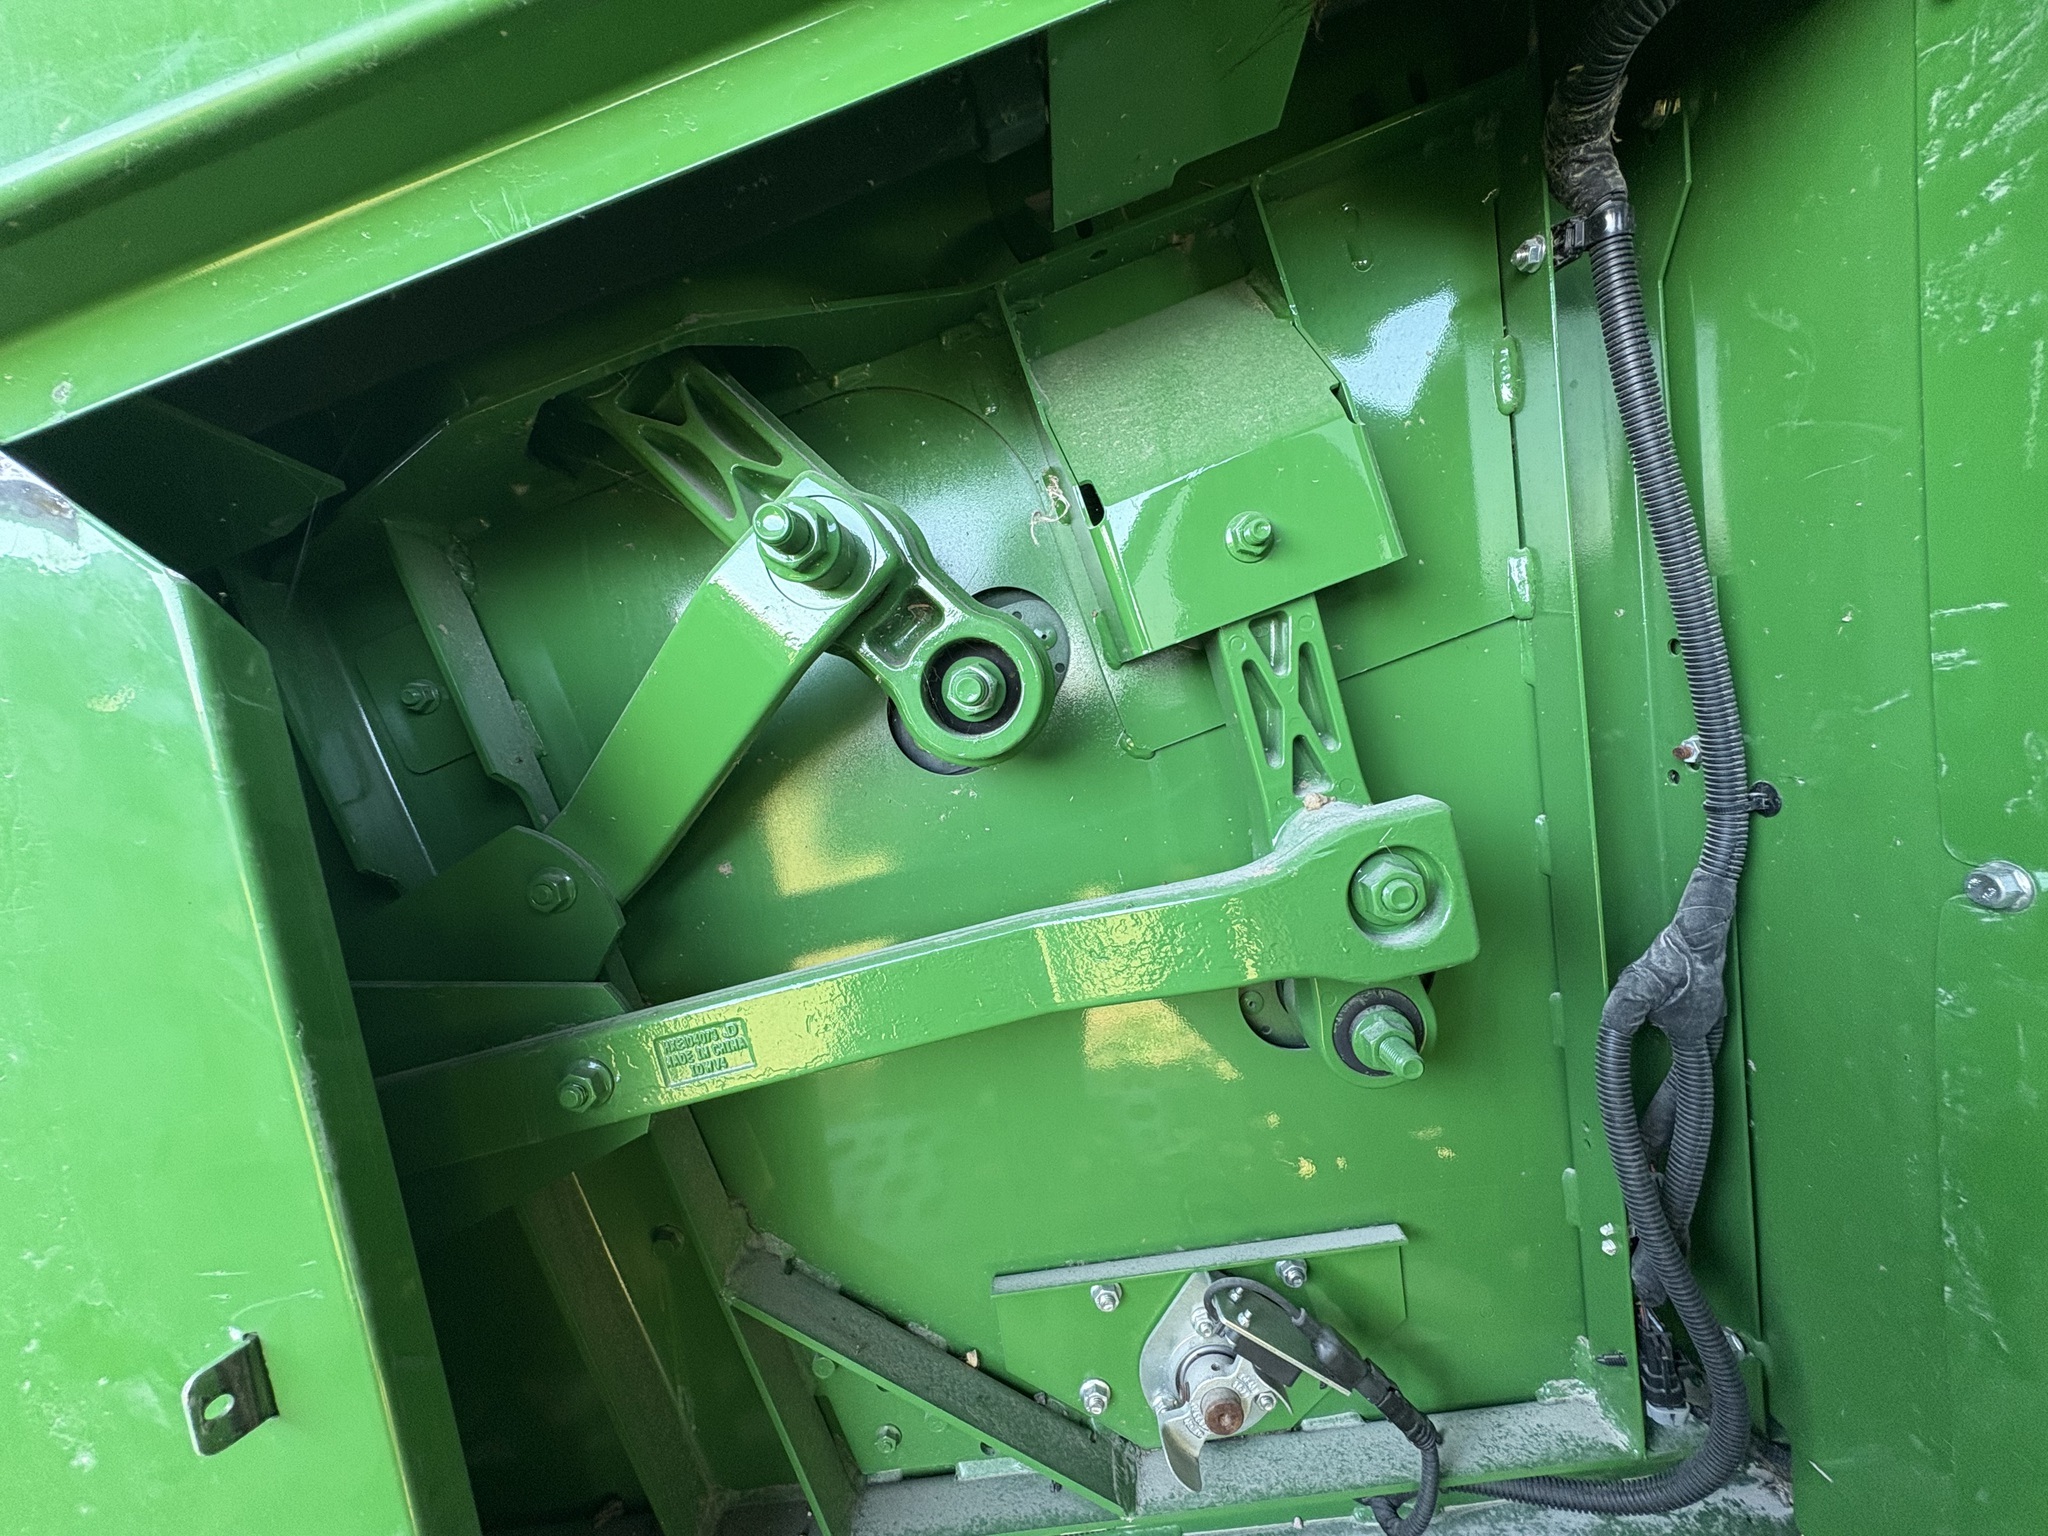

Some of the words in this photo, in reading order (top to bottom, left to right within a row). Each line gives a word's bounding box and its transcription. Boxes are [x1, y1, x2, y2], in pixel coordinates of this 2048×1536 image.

[665, 1050, 695, 1068] MADE
[695, 1046, 711, 1060] IN
[711, 1037, 748, 1056] CHINA
